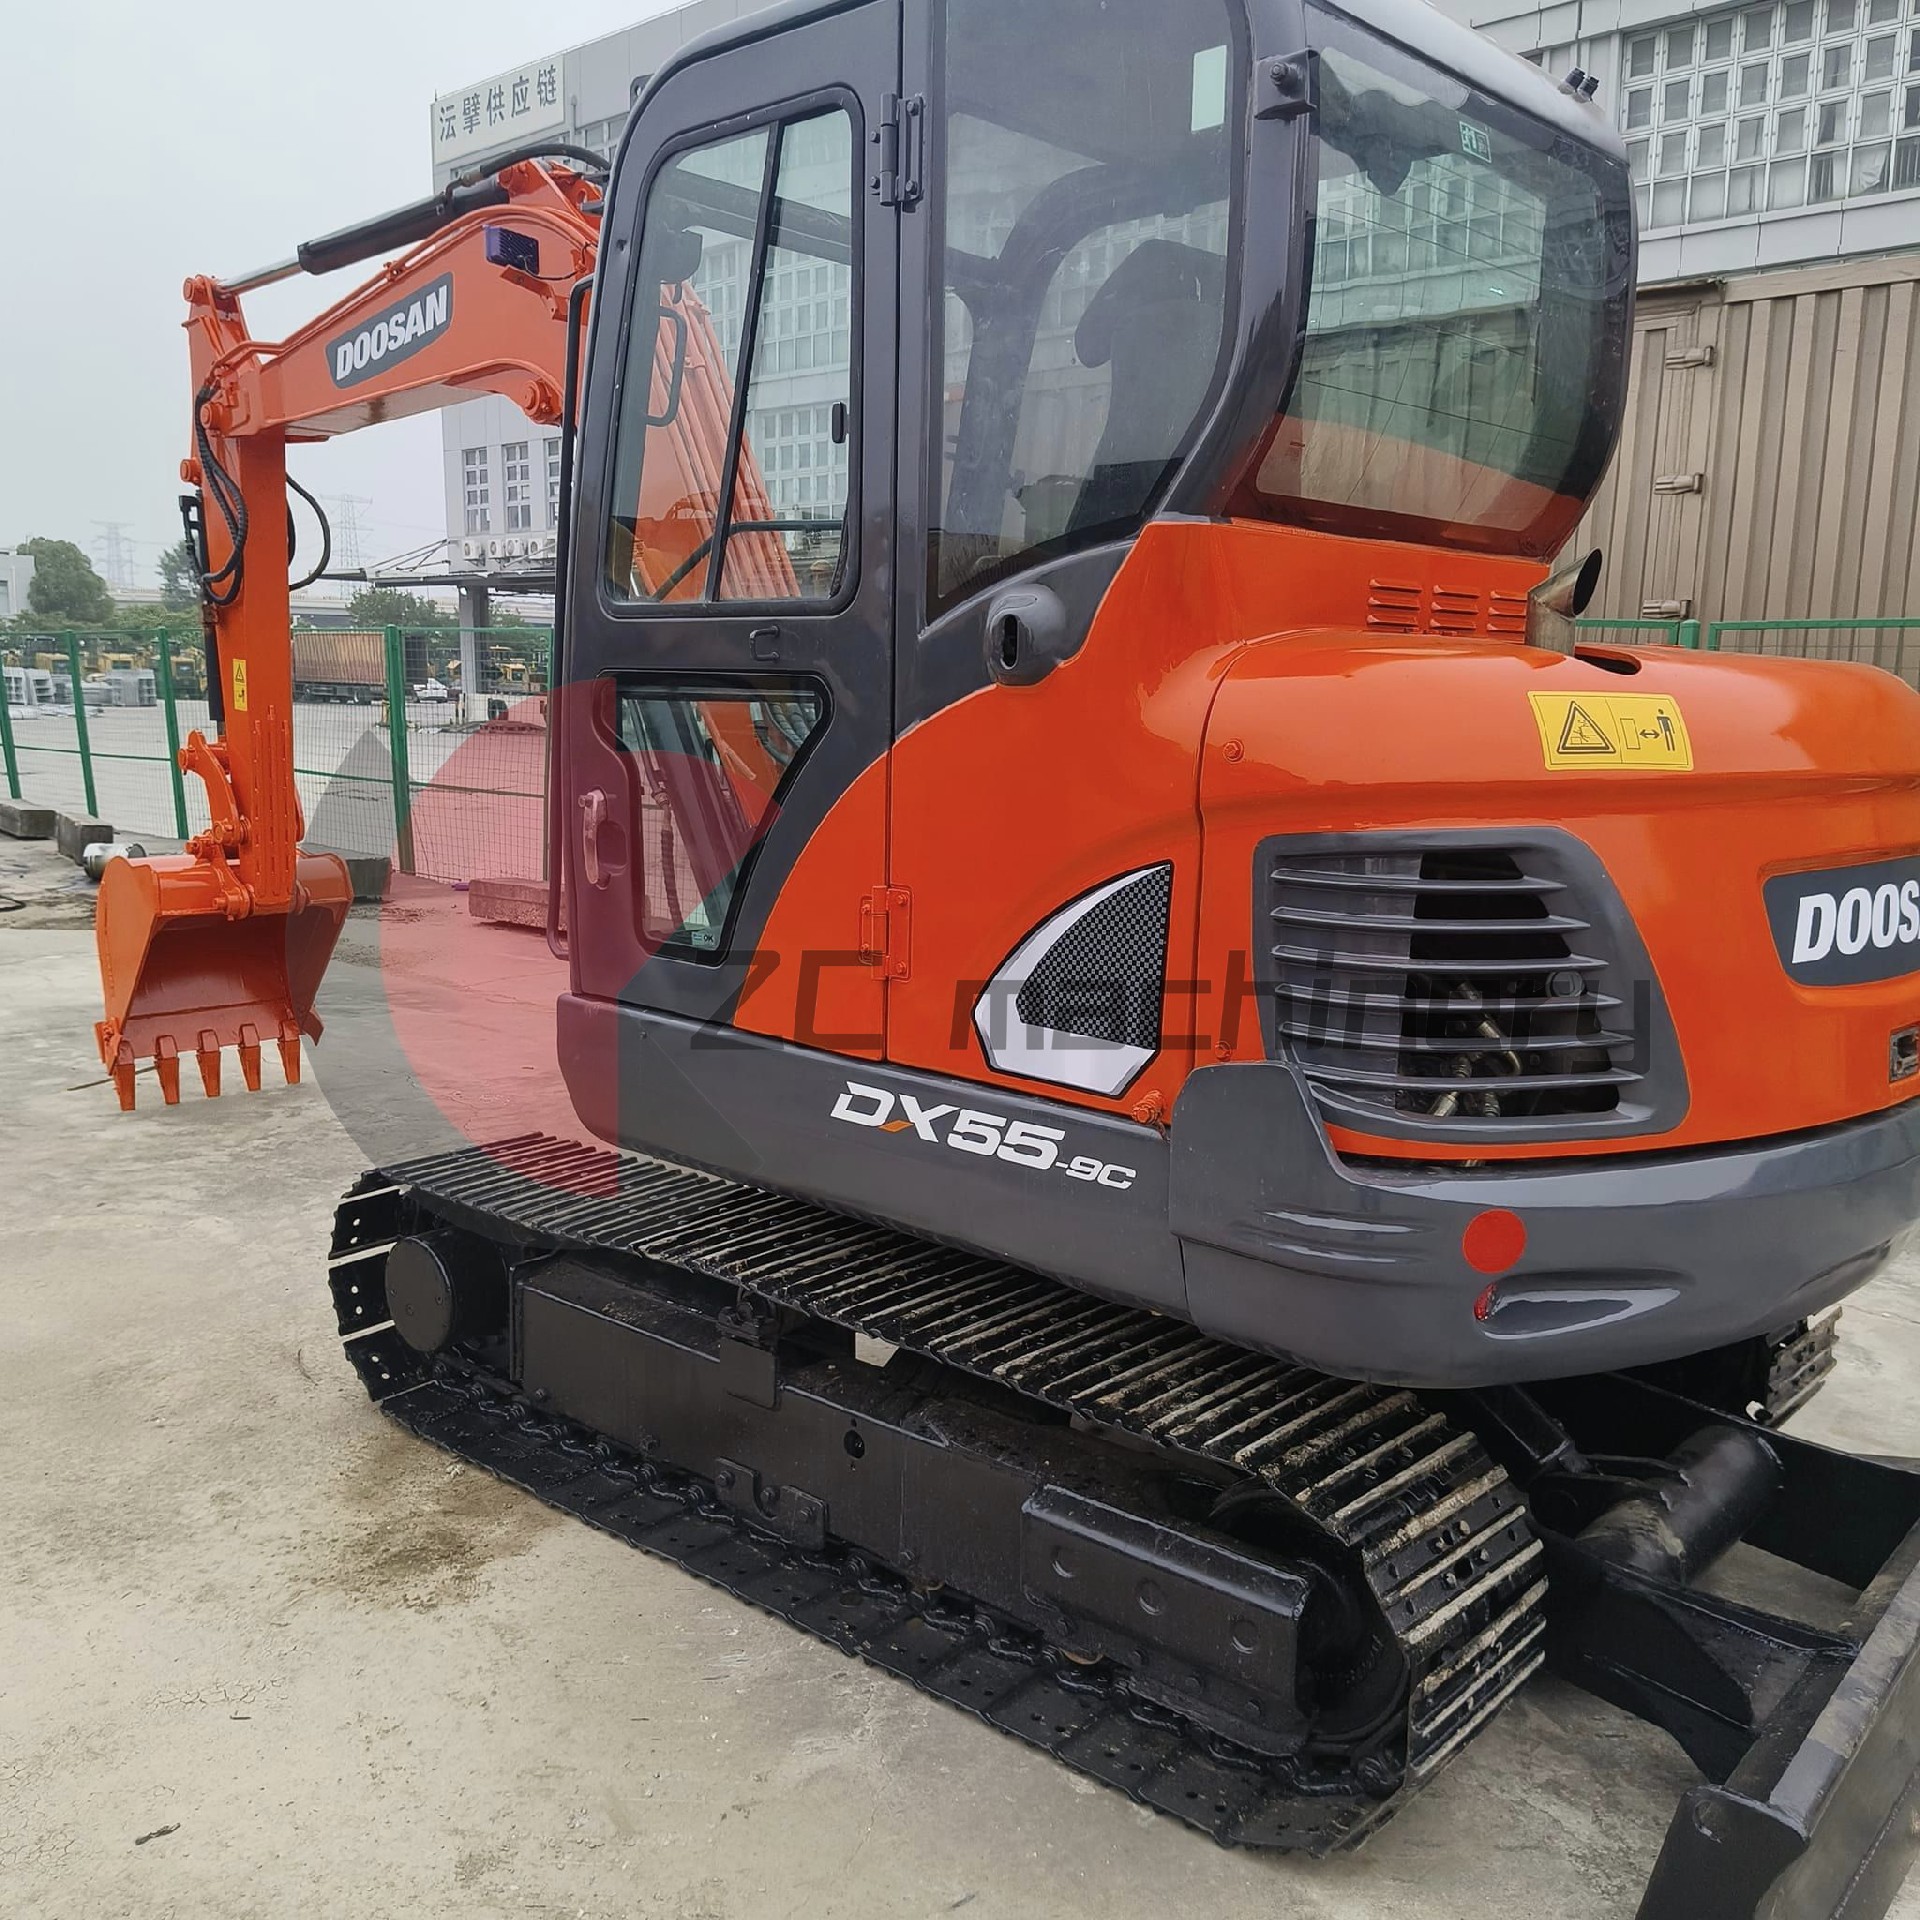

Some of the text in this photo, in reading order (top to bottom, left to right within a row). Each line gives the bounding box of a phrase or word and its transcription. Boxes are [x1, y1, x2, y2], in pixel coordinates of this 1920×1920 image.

[336, 284, 448, 381] DOOSAN
[1791, 879, 1920, 964] DOOS
[830, 1081, 1137, 1190] DX55-9C
